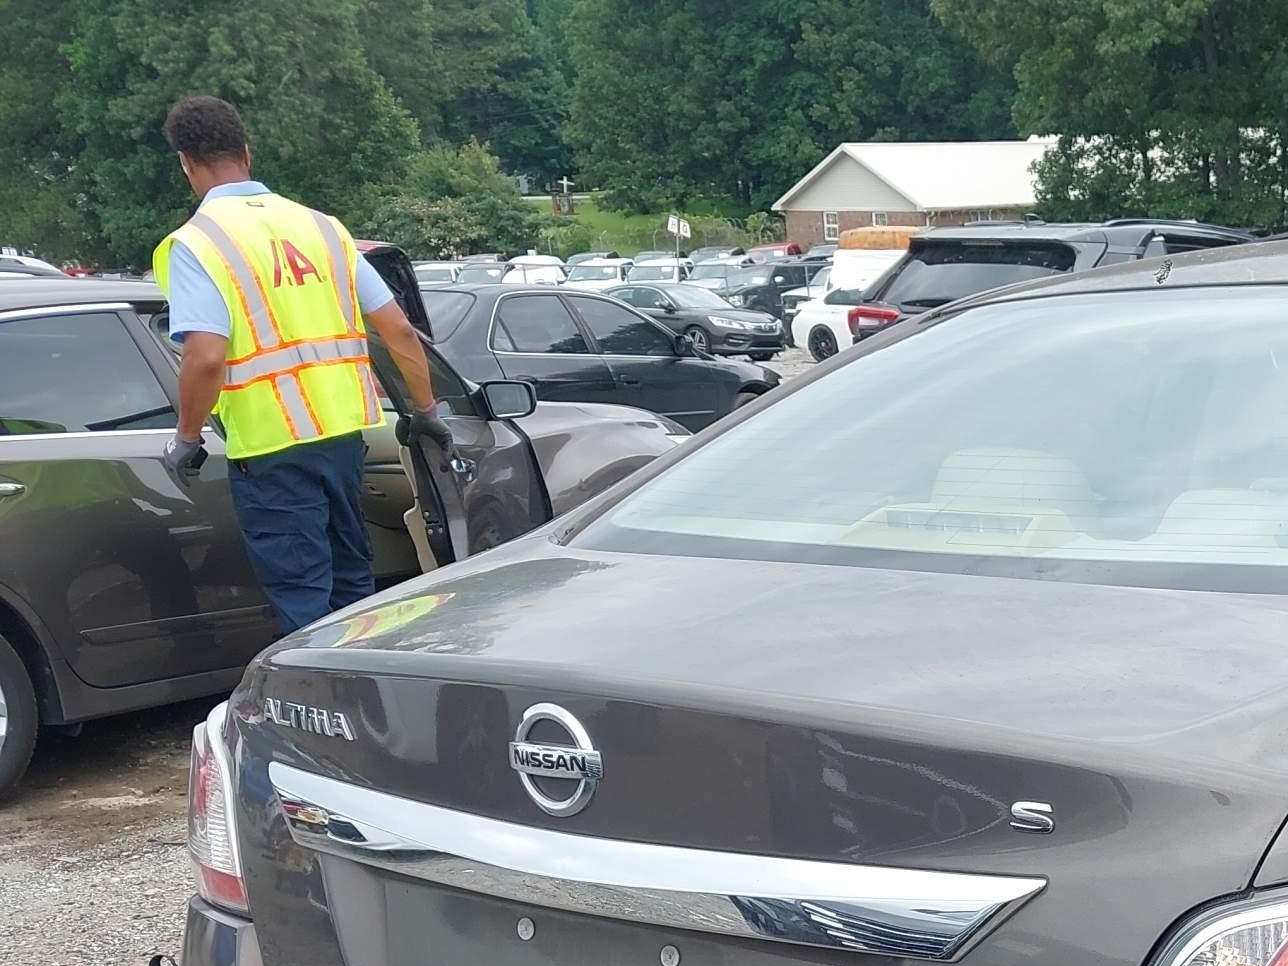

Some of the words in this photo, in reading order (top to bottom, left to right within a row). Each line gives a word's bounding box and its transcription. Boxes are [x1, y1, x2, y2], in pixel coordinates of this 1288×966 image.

[264, 697, 358, 741] ALTIMA
[513, 747, 587, 773] NISSAN
[1008, 801, 1055, 834] S
